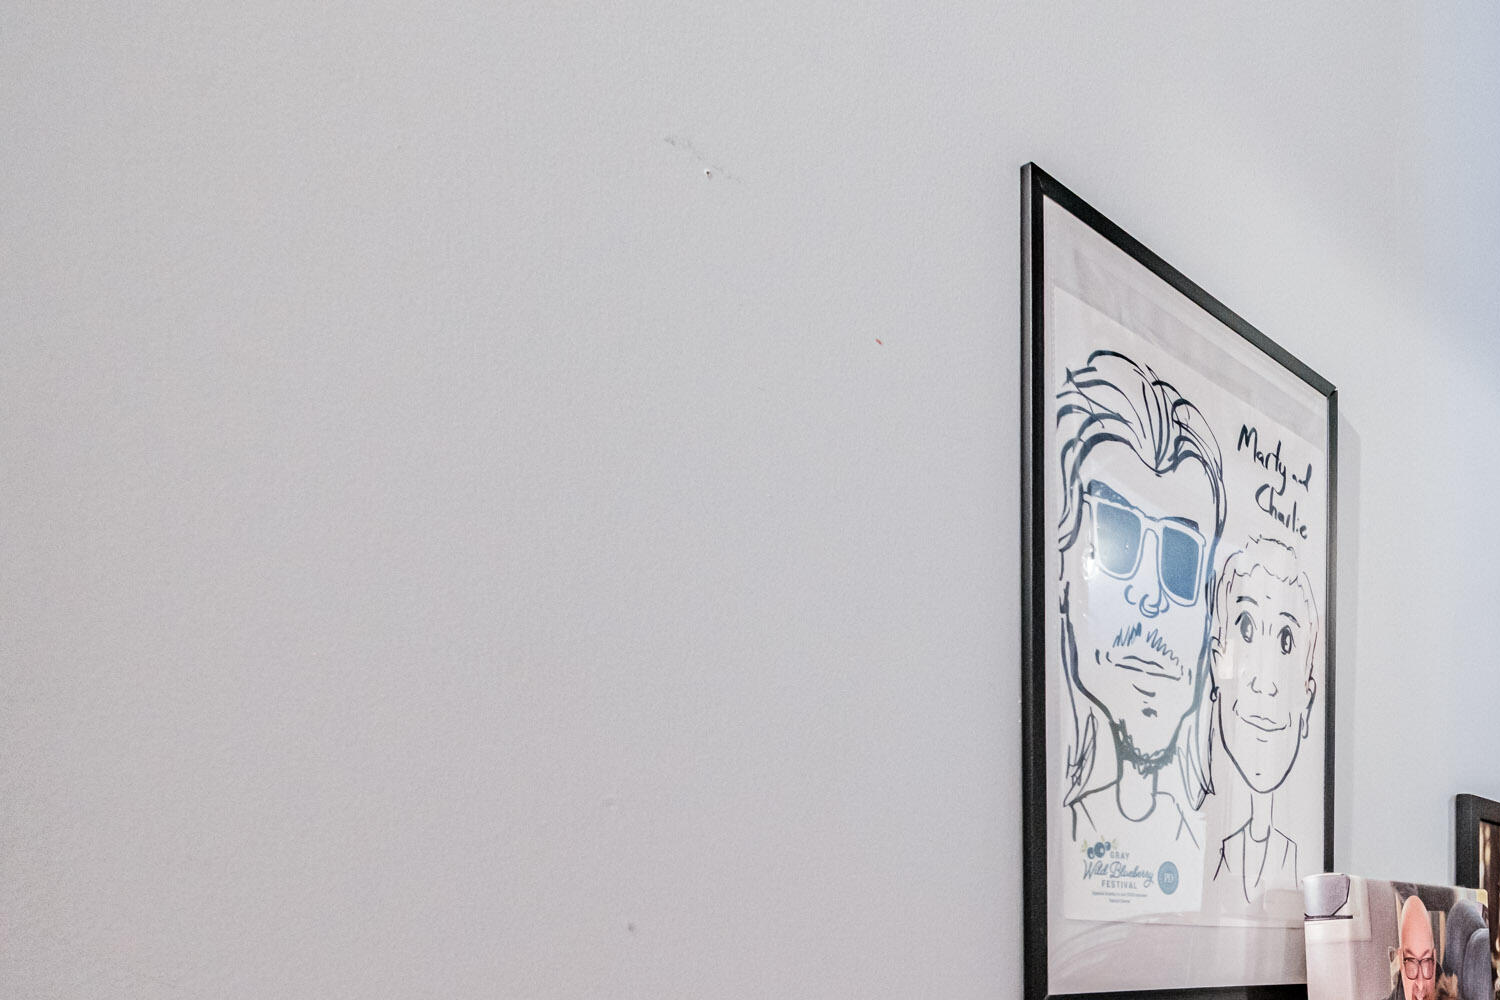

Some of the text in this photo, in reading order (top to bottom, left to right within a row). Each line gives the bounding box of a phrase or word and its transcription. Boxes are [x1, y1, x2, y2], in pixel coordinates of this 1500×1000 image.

[1237, 424, 1286, 496] Marty
[1255, 483, 1308, 539] Charlie
[1110, 851, 1130, 859] GRAY
[1083, 859, 1154, 888] Wild Blueberry
[1101, 880, 1138, 889] FESTIVAL
